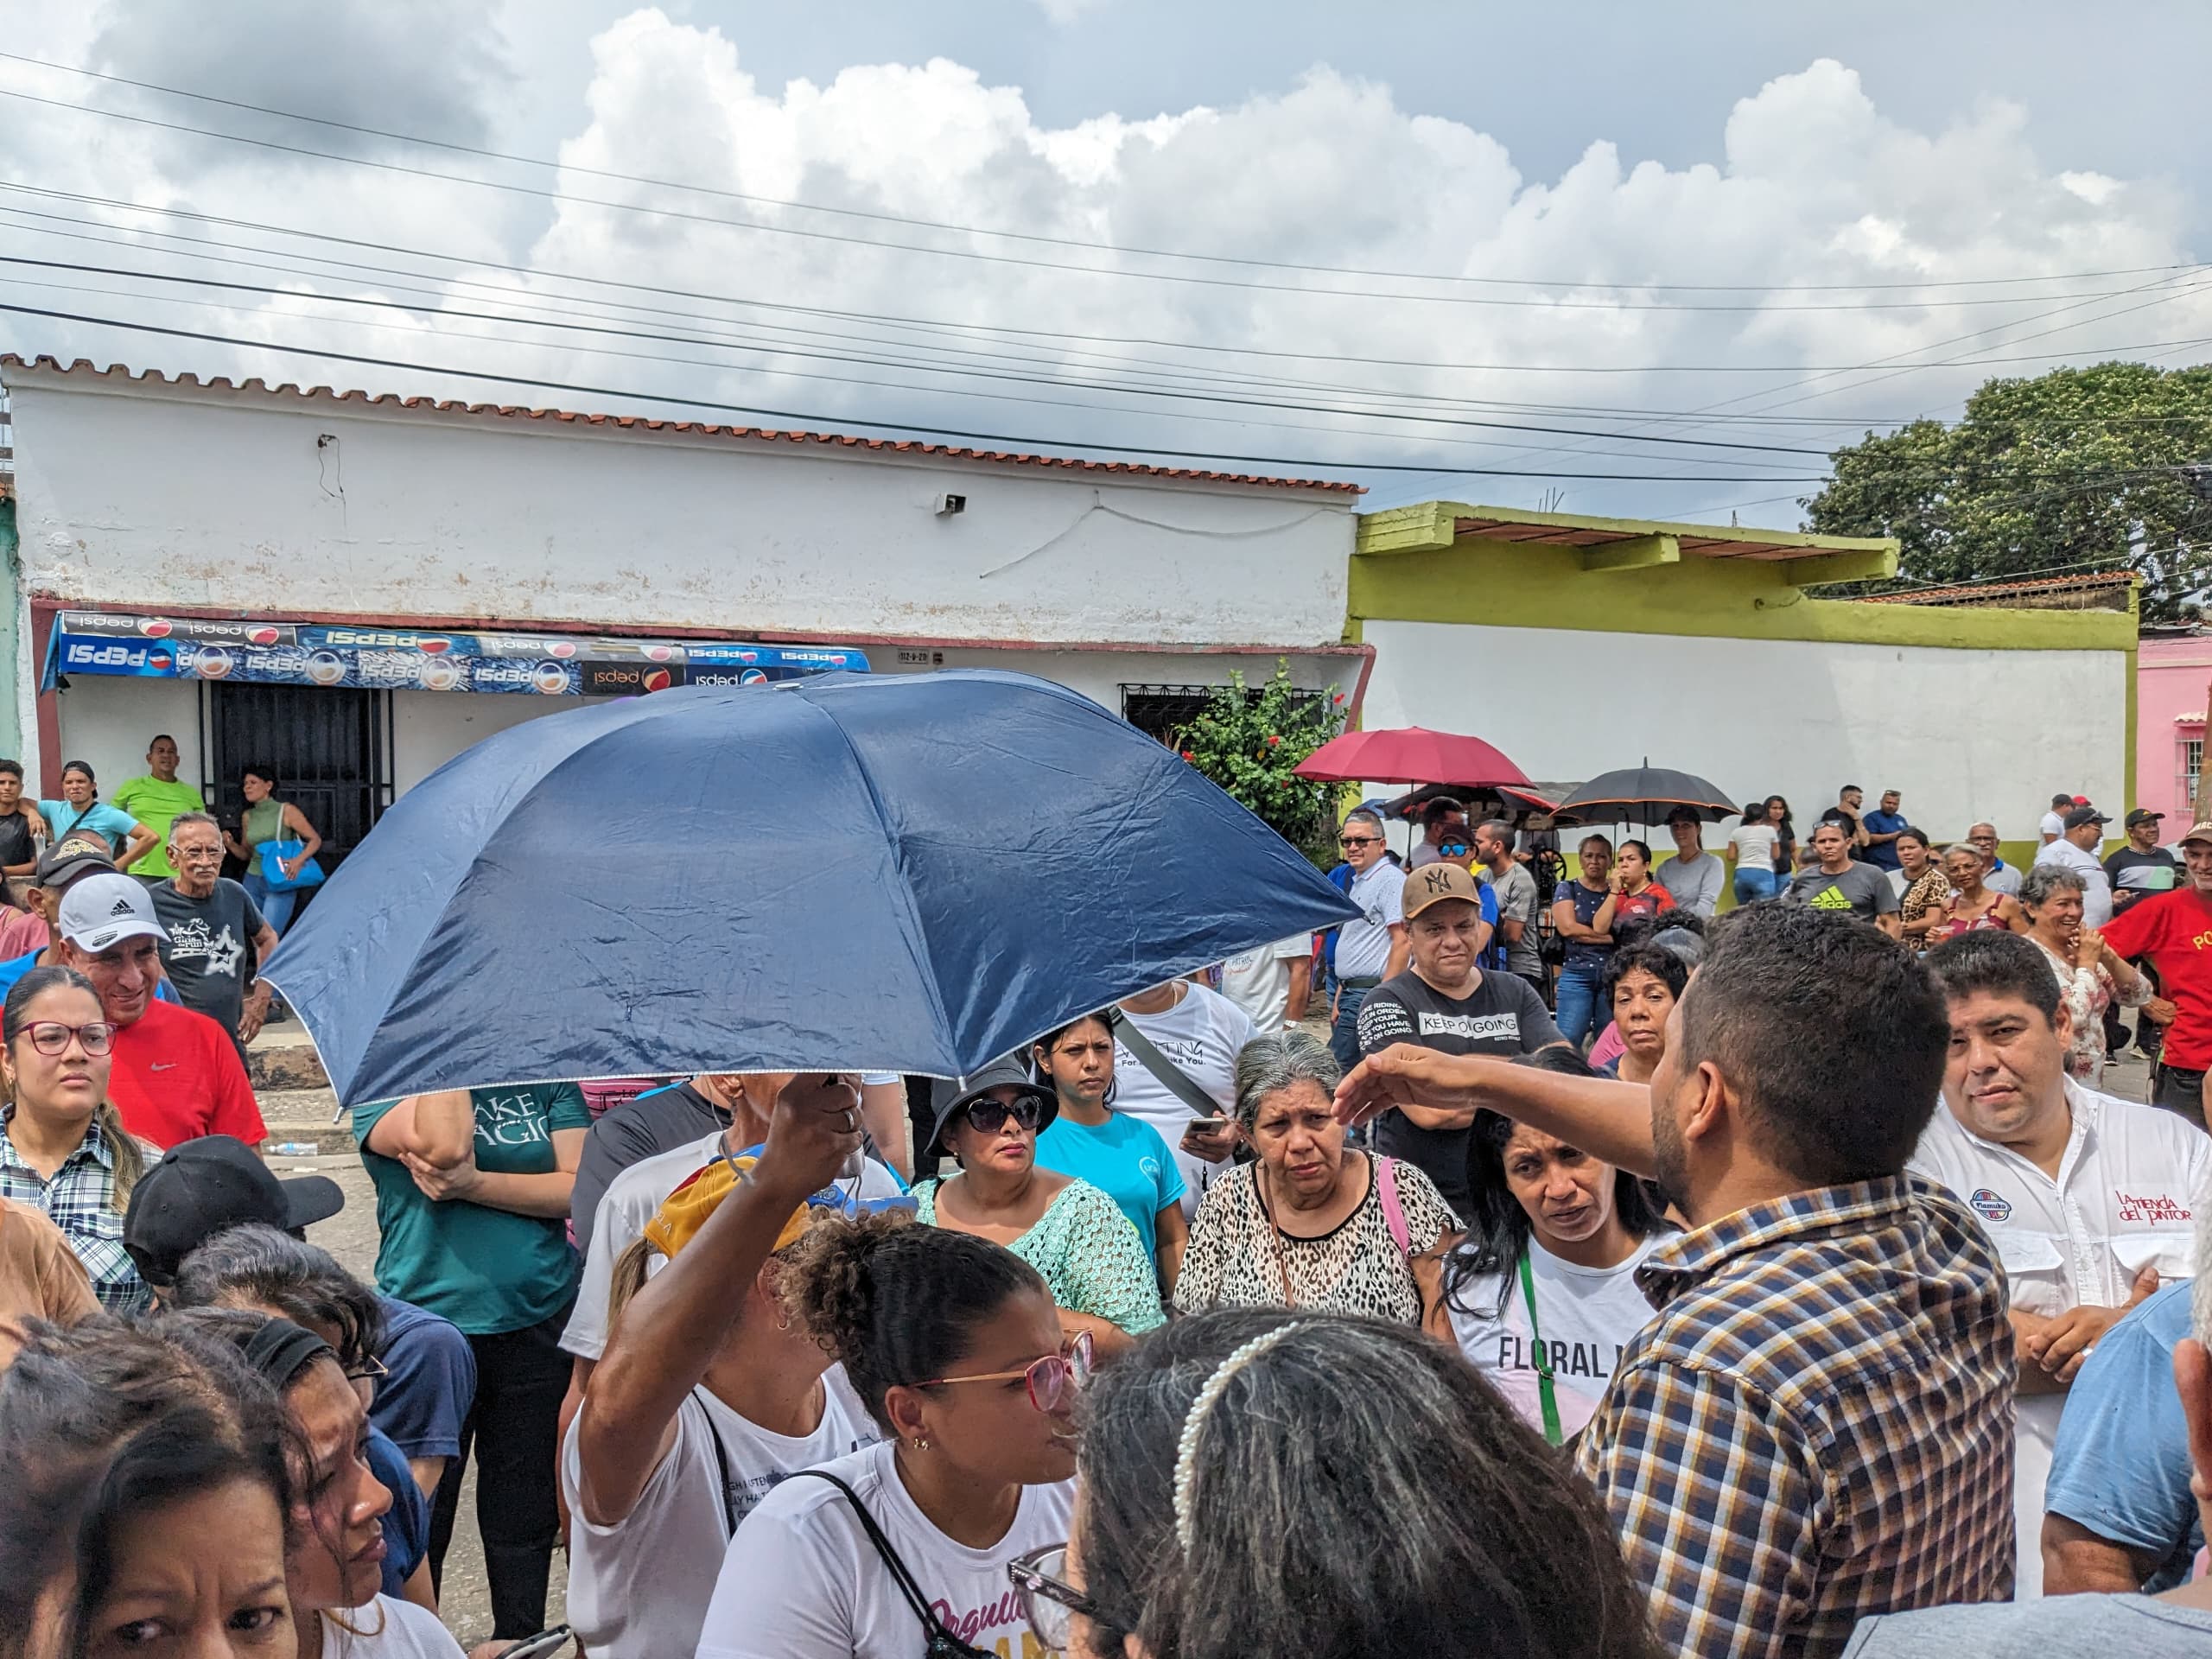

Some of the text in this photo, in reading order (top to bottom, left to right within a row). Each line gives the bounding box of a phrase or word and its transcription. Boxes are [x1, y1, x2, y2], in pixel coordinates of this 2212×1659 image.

[79, 616, 133, 628] pepsi
[189, 625, 242, 635] pepsi
[326, 631, 418, 646] PEPSI
[492, 641, 541, 651] pepsi
[67, 644, 148, 667] PEPSI
[689, 649, 741, 658] PEPSI
[781, 652, 831, 662] PEPSI
[246, 655, 306, 671] PEPSI
[362, 664, 422, 679] PEPSI
[475, 668, 534, 683] PEPSI
[594, 671, 639, 684] pepsi
[696, 674, 738, 686] pepsi
[2192, 930, 2212, 950] PO
[1374, 1014, 1398, 1023] YOUR
[1371, 1023, 1386, 1033] YOU
[1424, 1018, 1455, 1030] KEEP
[1473, 1019, 1516, 1033] GOING
[1374, 1032, 1383, 1040] ON
[1384, 1027, 1413, 1036] GOING
[1170, 1055, 1183, 1065] ike
[1187, 1057, 1206, 1065] You.
[474, 1092, 537, 1122] AKE
[1499, 1337, 1608, 1377] FLORAL
[924, 1590, 1027, 1645] Orgull
